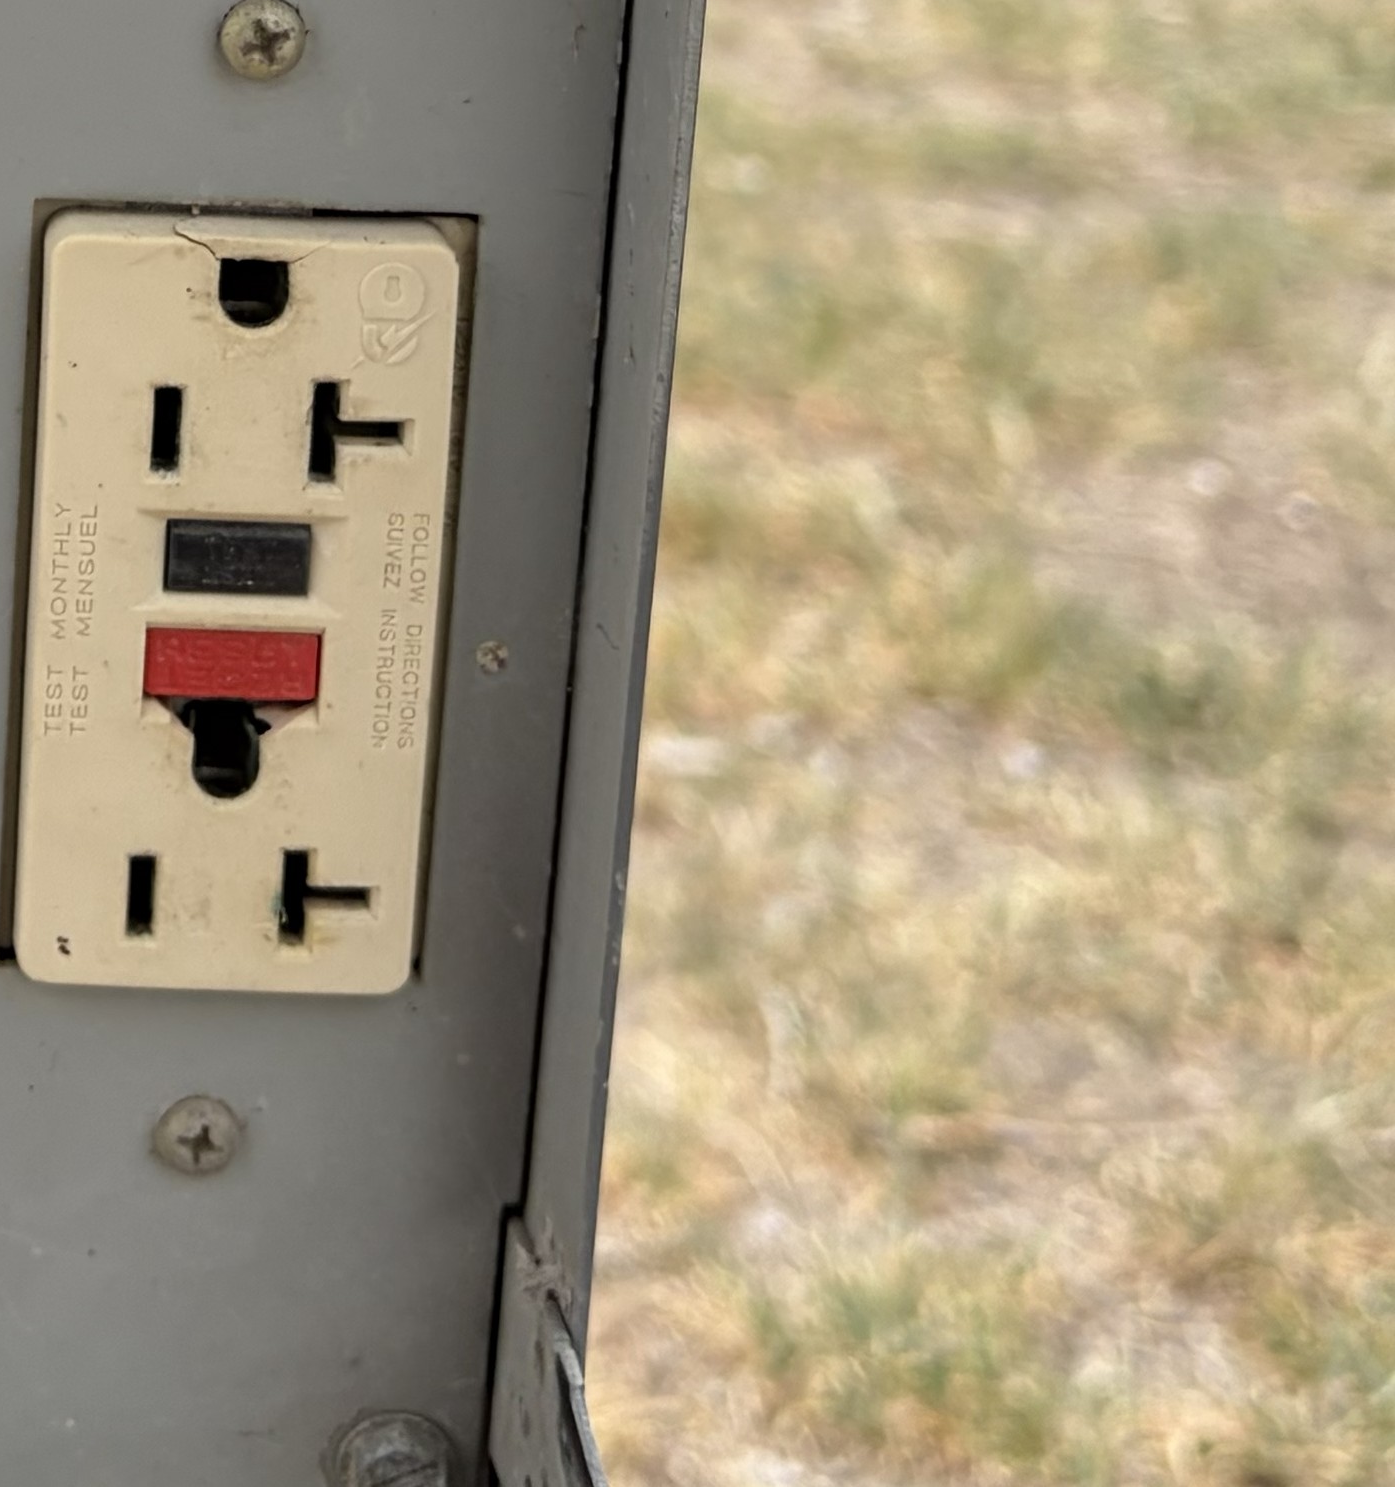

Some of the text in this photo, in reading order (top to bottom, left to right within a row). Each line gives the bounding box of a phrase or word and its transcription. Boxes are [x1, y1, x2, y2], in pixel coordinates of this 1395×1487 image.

[43, 502, 72, 737] TEST MONTHLY
[69, 502, 99, 737] TEST MENSUEL
[371, 512, 405, 749] SUIVEZ INSTRUCTION
[396, 512, 431, 750] FOLLOW DIRECTIONS
